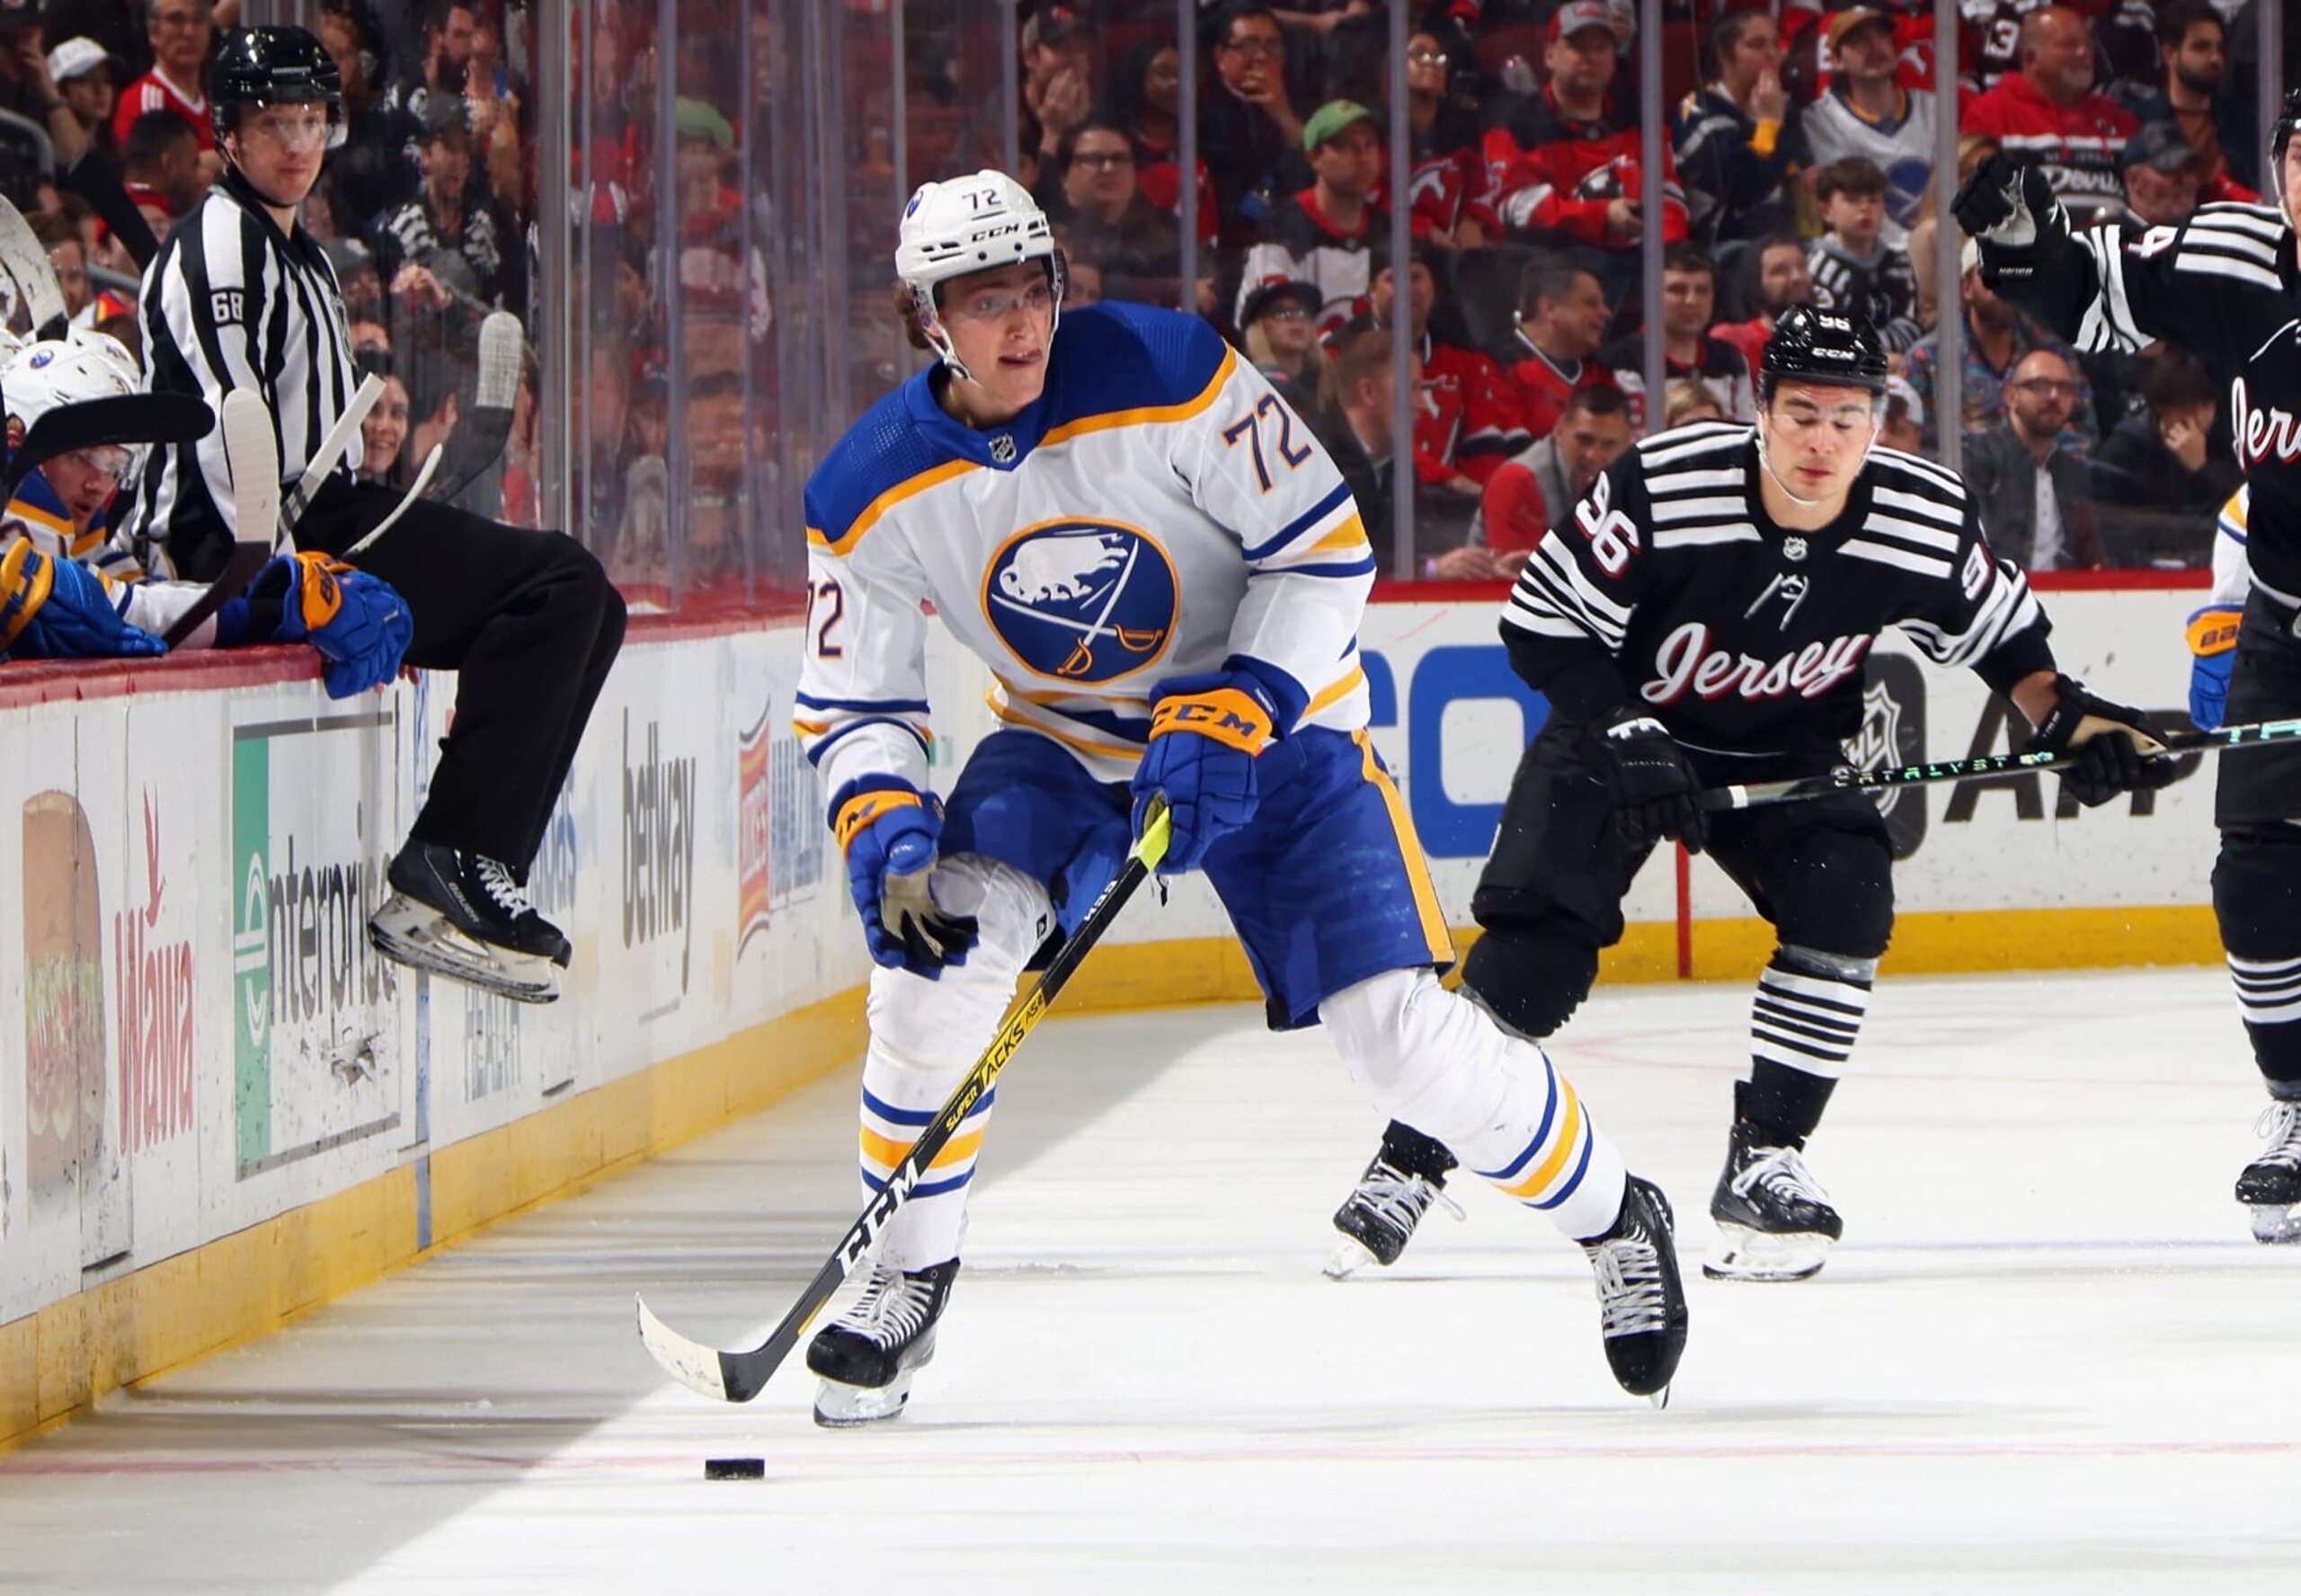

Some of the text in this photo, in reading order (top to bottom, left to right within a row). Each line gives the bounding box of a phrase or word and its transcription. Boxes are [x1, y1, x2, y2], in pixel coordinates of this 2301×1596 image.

[962, 188, 1001, 210] 72
[972, 222, 1019, 243] CCM
[211, 291, 244, 324] 68
[1818, 315, 1852, 332] 96
[1812, 347, 1856, 361] CCM
[1220, 391, 1315, 495] 72
[2231, 376, 2301, 474] Jer
[1575, 470, 1641, 581] 96
[1640, 622, 1872, 707] Jersey
[1152, 704, 1257, 738] CCM
[623, 705, 696, 997] betway
[115, 906, 194, 1157] Wawa
[946, 1085, 979, 1132] SUPER
[836, 1157, 920, 1278] CCM
